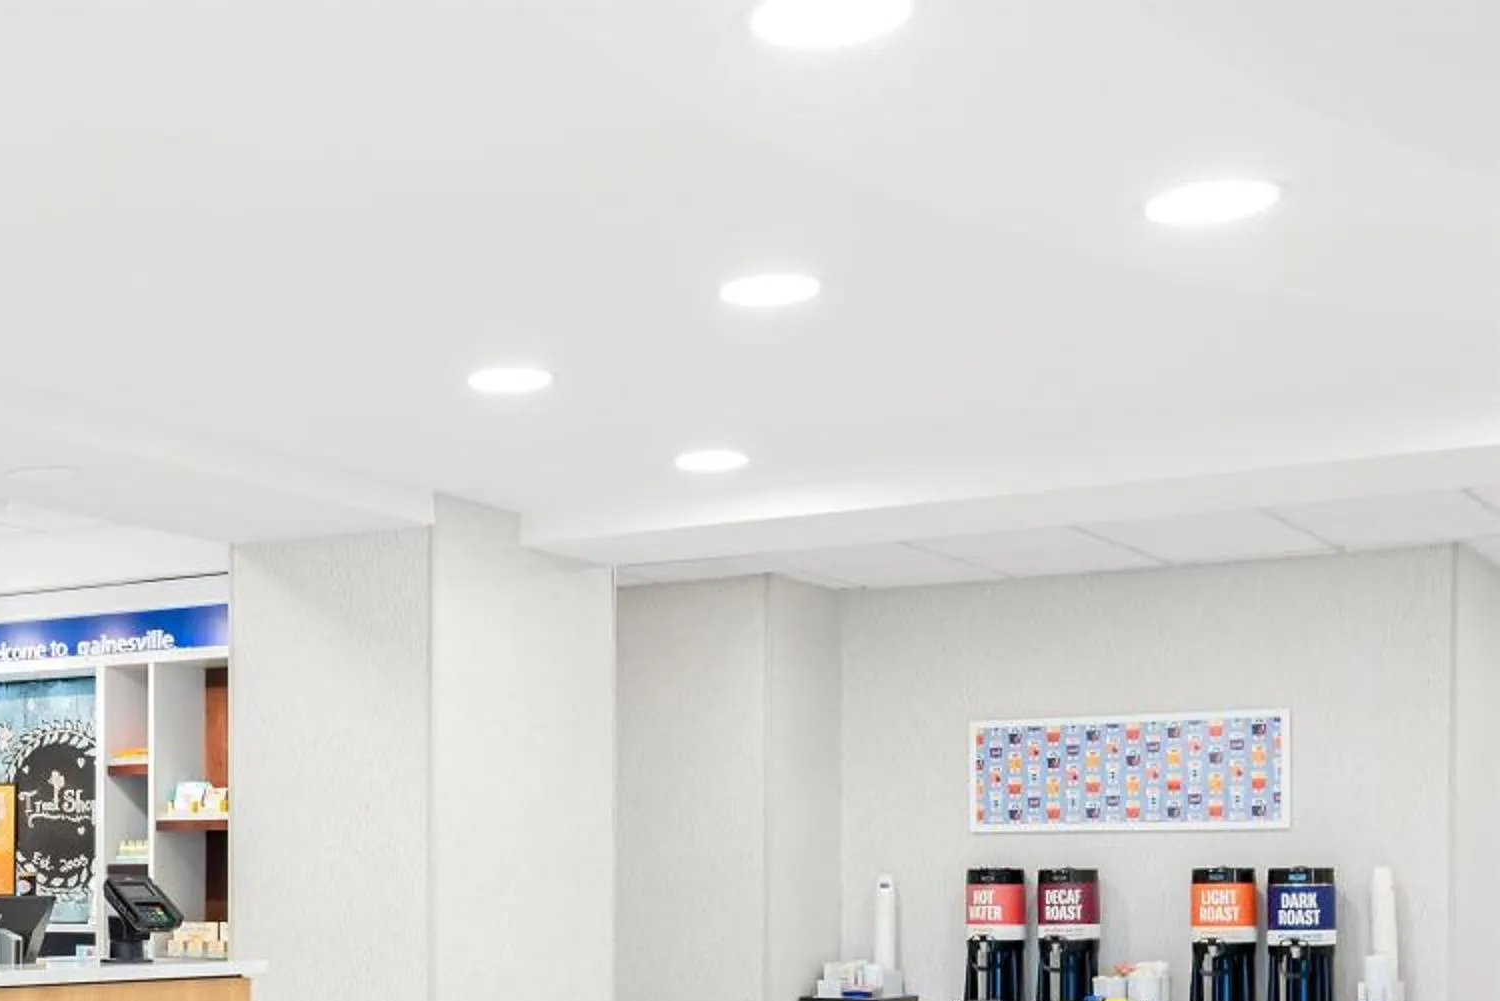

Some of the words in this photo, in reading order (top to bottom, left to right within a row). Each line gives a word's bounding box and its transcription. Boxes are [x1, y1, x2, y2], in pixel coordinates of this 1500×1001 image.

[50, 640, 68, 657] to
[77, 629, 175, 656] gainesville
[973, 889, 996, 905] HOT
[1044, 889, 1083, 905] DECAF
[1201, 889, 1238, 905] LIGHT
[1280, 892, 1317, 909] DARK
[1044, 905, 1083, 921] ROAST
[1200, 906, 1240, 922] ROAST
[1278, 909, 1321, 926] ROAST
